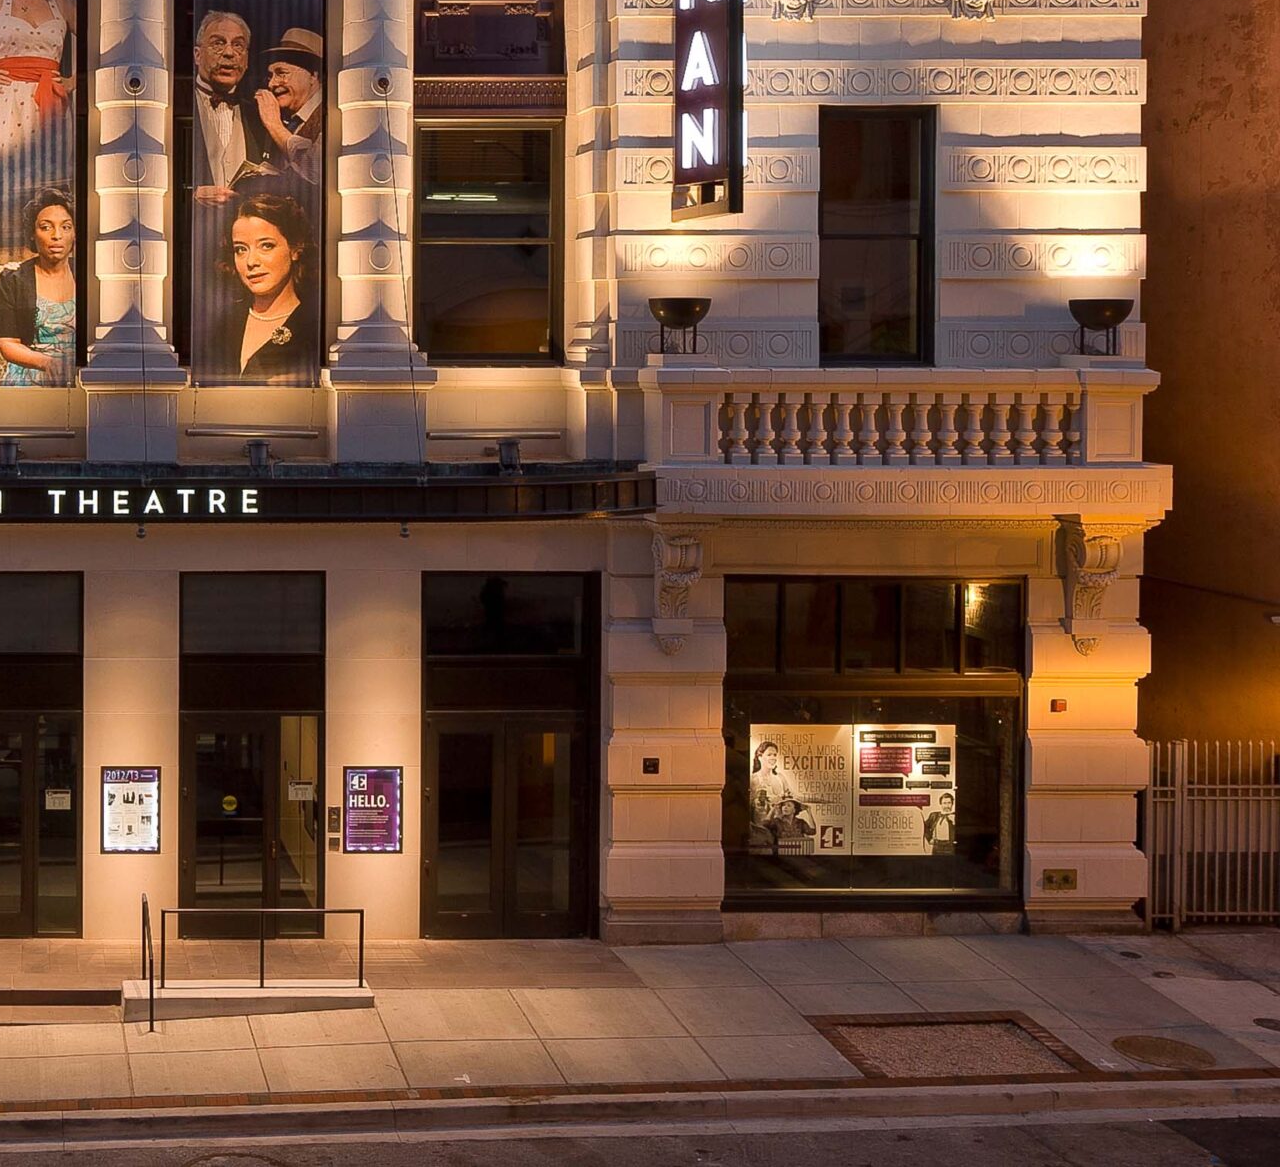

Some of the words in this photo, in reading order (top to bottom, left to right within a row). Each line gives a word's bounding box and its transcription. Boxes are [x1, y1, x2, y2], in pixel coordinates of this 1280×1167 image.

[48, 489, 259, 514] THEATRE
[759, 734, 788, 744] THERE
[793, 734, 815, 744] JUST
[807, 745, 812, 755] A
[816, 745, 841, 755] MORE
[783, 756, 845, 770] EXCITING
[106, 770, 139, 781] 2012/13
[793, 771, 814, 781] YEAR
[818, 771, 829, 781] TO
[832, 771, 847, 781] SEE
[798, 782, 849, 792] EVERYMAN
[349, 794, 390, 808] HELLO.
[803, 793, 843, 803] THEATRE
[816, 805, 847, 815] PERIOD
[858, 816, 914, 829] SUBSCRIBE
